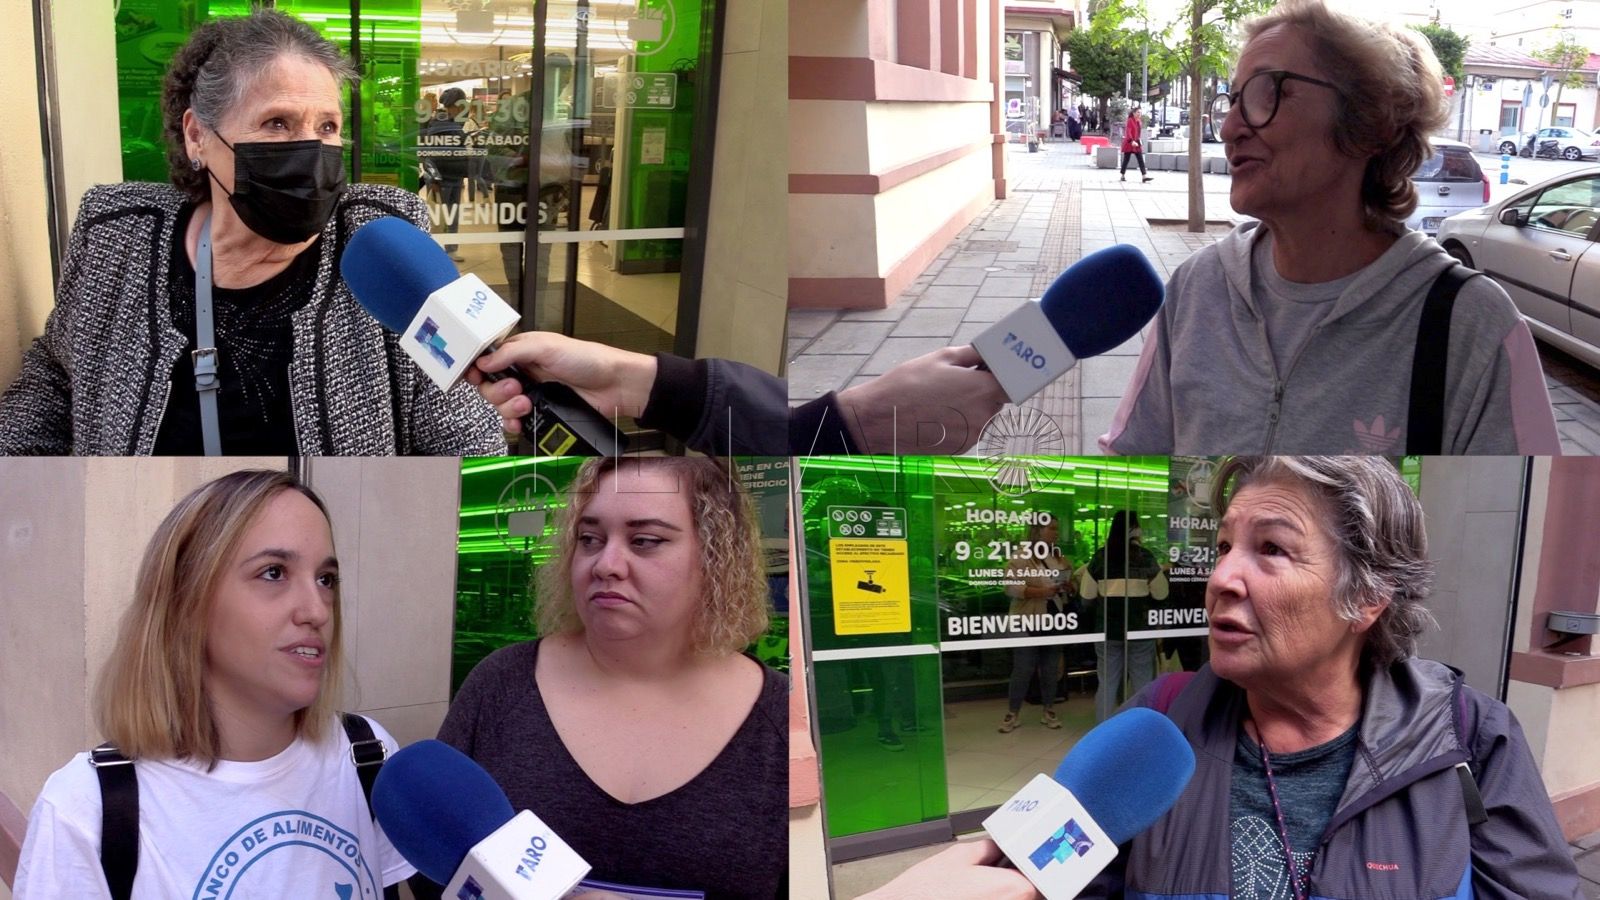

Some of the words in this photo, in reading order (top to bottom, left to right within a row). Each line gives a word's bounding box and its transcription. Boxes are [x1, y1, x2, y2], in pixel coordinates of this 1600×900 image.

[415, 99, 433, 123] 9
[417, 135, 461, 146] LUNES
[463, 135, 475, 146] A
[757, 463, 771, 471] EN
[967, 508, 1052, 526] HORARIO
[955, 541, 971, 561] 9
[974, 546, 985, 559] a
[1169, 546, 1181, 563] 9
[968, 568, 1004, 578] LUNES
[1006, 568, 1015, 578] A
[1016, 566, 1060, 578] SÁBADO
[1169, 567, 1196, 575] LUNES
[1197, 567, 1204, 575] A
[947, 612, 1079, 636] BIENVENIDOS
[241, 828, 268, 852] DE
